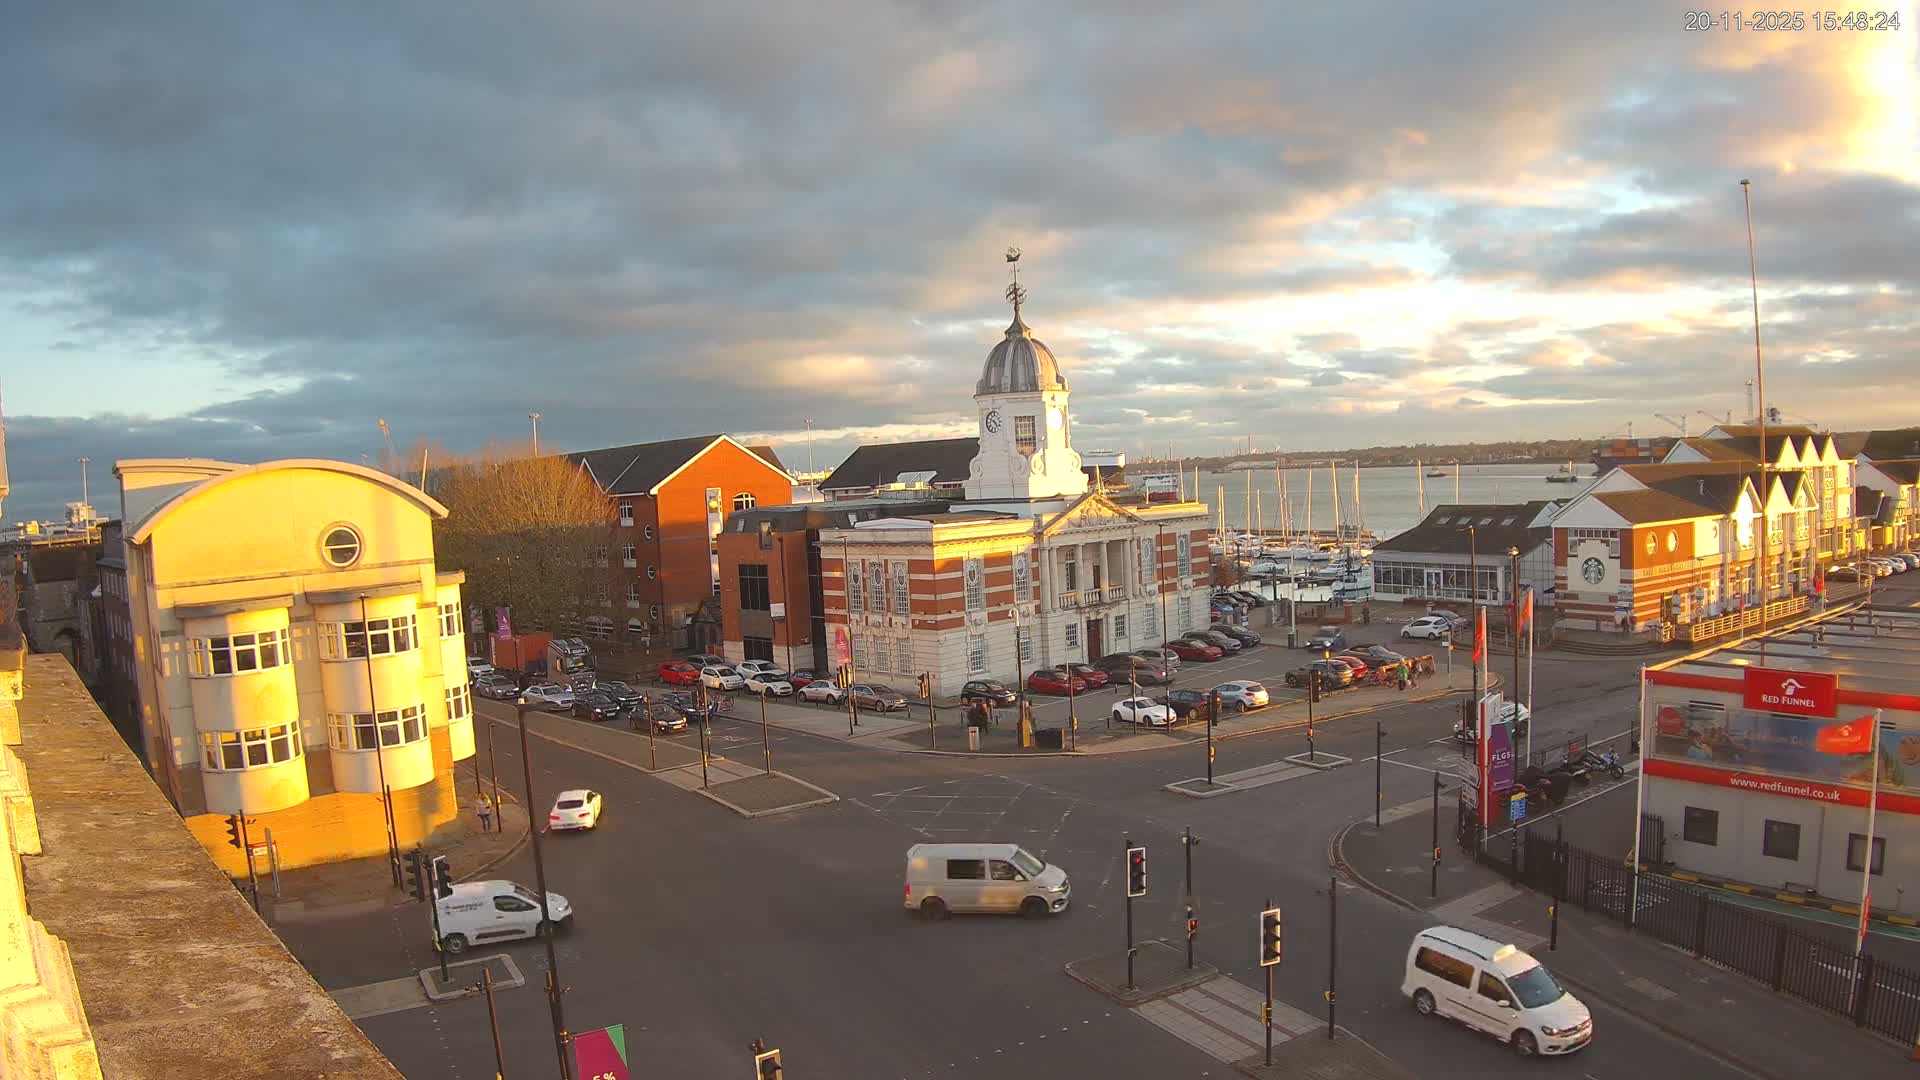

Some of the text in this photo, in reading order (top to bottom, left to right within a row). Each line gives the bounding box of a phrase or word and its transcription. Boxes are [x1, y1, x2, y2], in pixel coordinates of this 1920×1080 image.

[1762, 694, 1816, 708] RED FUNNEL
[1730, 777, 1841, 801] www.redfunnel.co.uk
